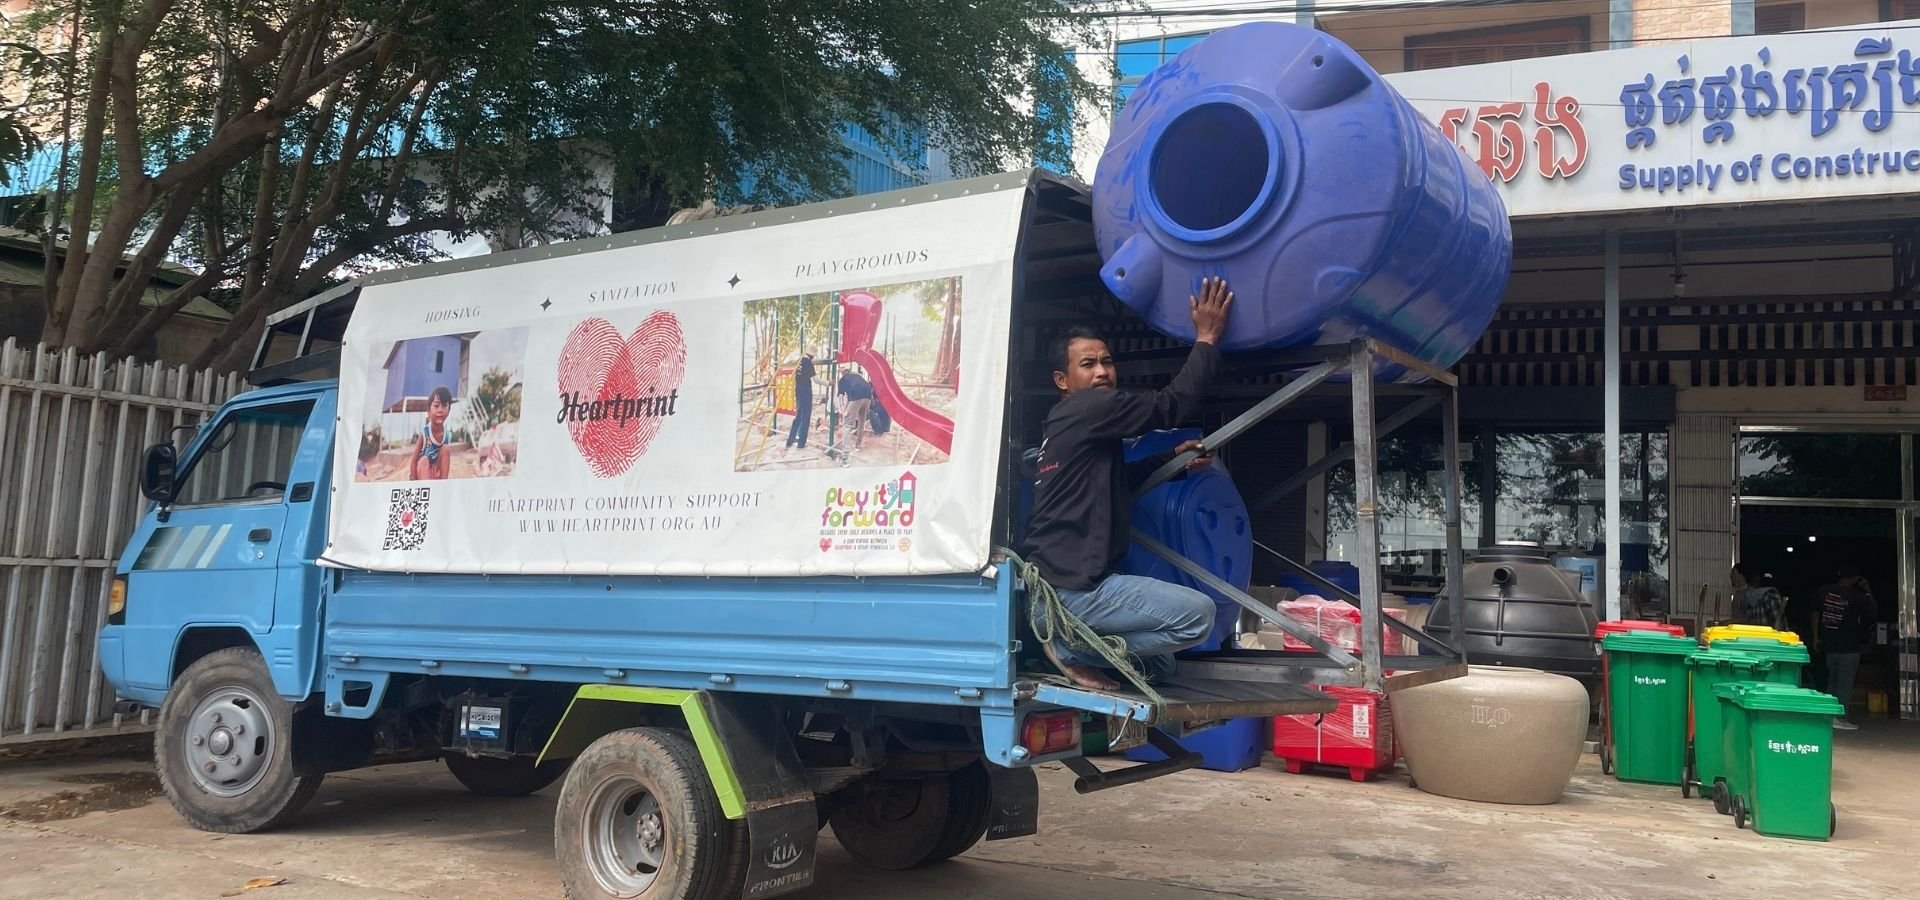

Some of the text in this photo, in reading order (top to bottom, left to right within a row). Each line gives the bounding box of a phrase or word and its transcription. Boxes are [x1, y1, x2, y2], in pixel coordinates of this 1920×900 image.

[1619, 158, 1722, 192] Supply
[1731, 153, 1762, 182] of
[795, 248, 929, 278] PLAYGROUNDS
[588, 281, 678, 304] SANITATION
[425, 306, 481, 324] HOUSING
[557, 386, 678, 428] Heartprint
[488, 492, 762, 512] HEARTPRINT COMMUNITY SUPPORT
[873, 484, 887, 506] it
[822, 500, 915, 527] forward
[772, 842, 797, 862] KIA
[750, 870, 809, 893] FRONTIER
